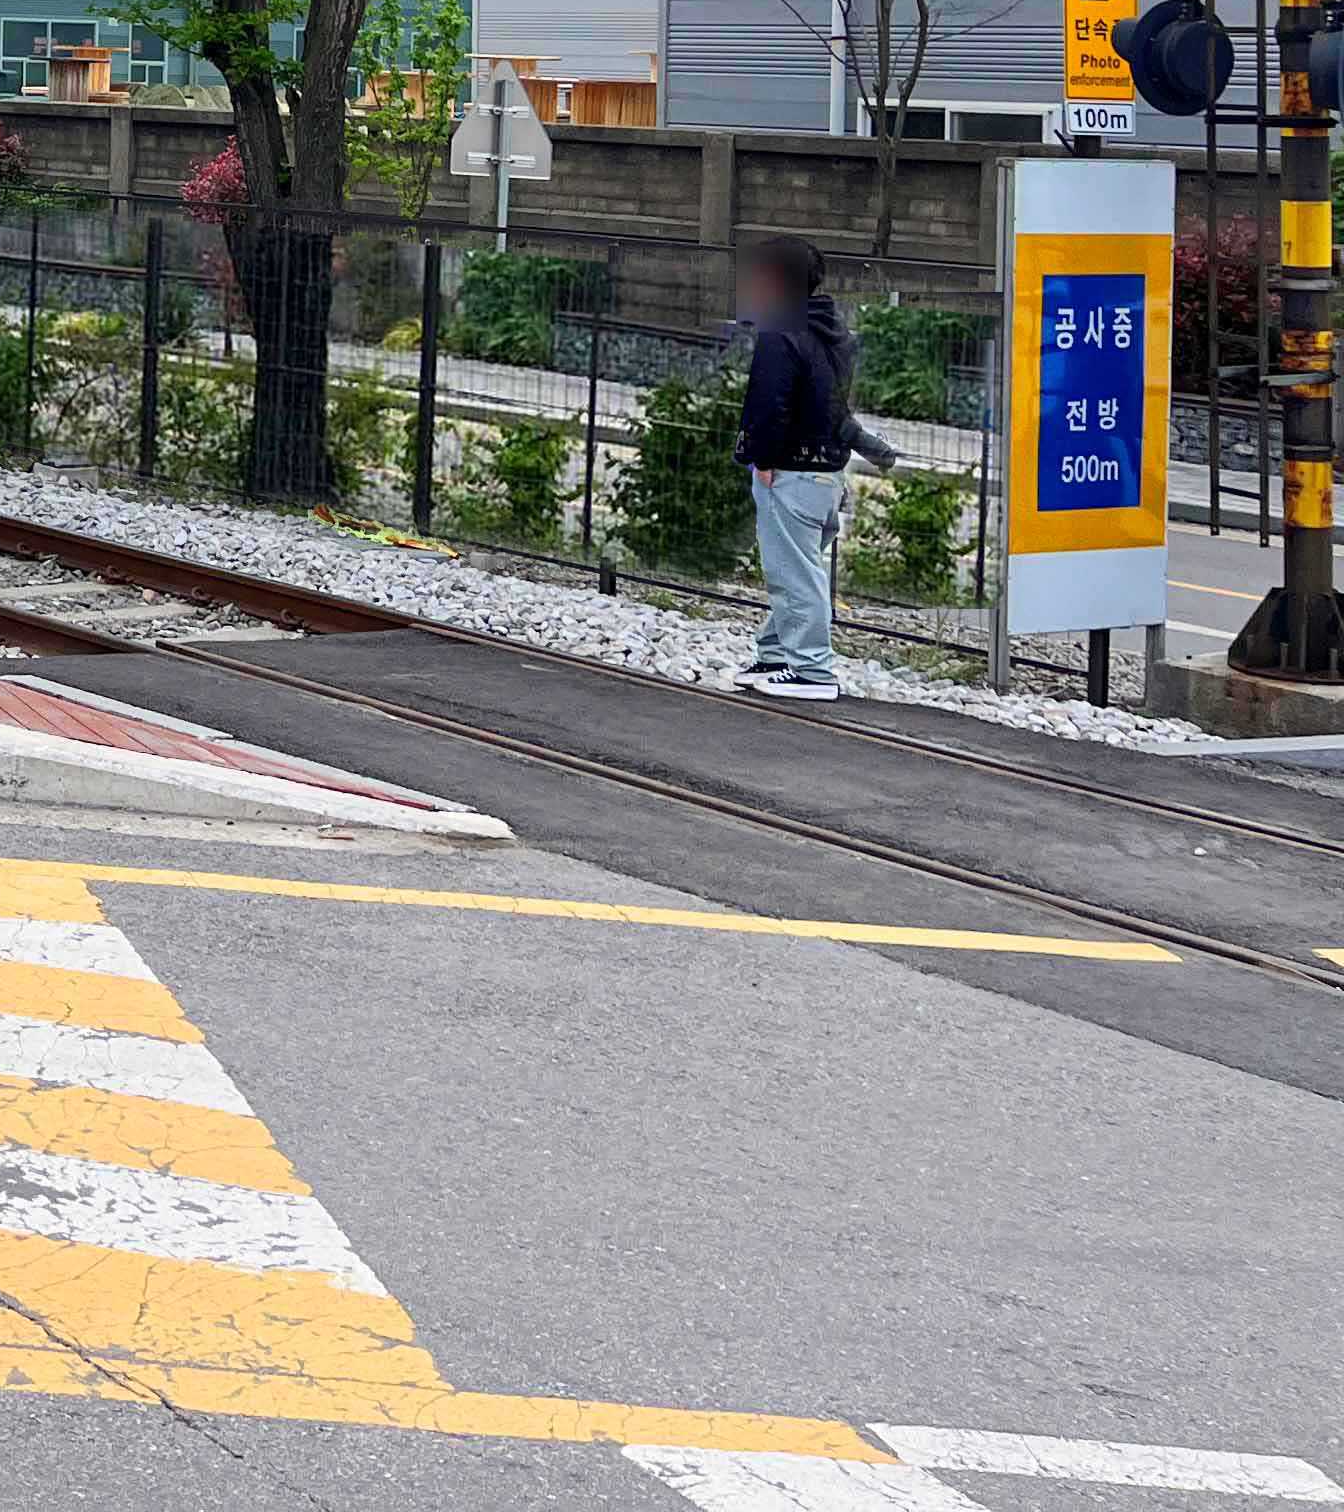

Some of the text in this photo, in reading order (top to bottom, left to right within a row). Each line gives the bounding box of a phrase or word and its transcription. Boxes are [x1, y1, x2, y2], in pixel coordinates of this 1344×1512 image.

[1075, 17, 1120, 41] 단속
[1080, 54, 1121, 69] Photo
[1073, 108, 1127, 129] 100m
[1065, 398, 1120, 432] 전방
[1061, 454, 1119, 483] 500m
